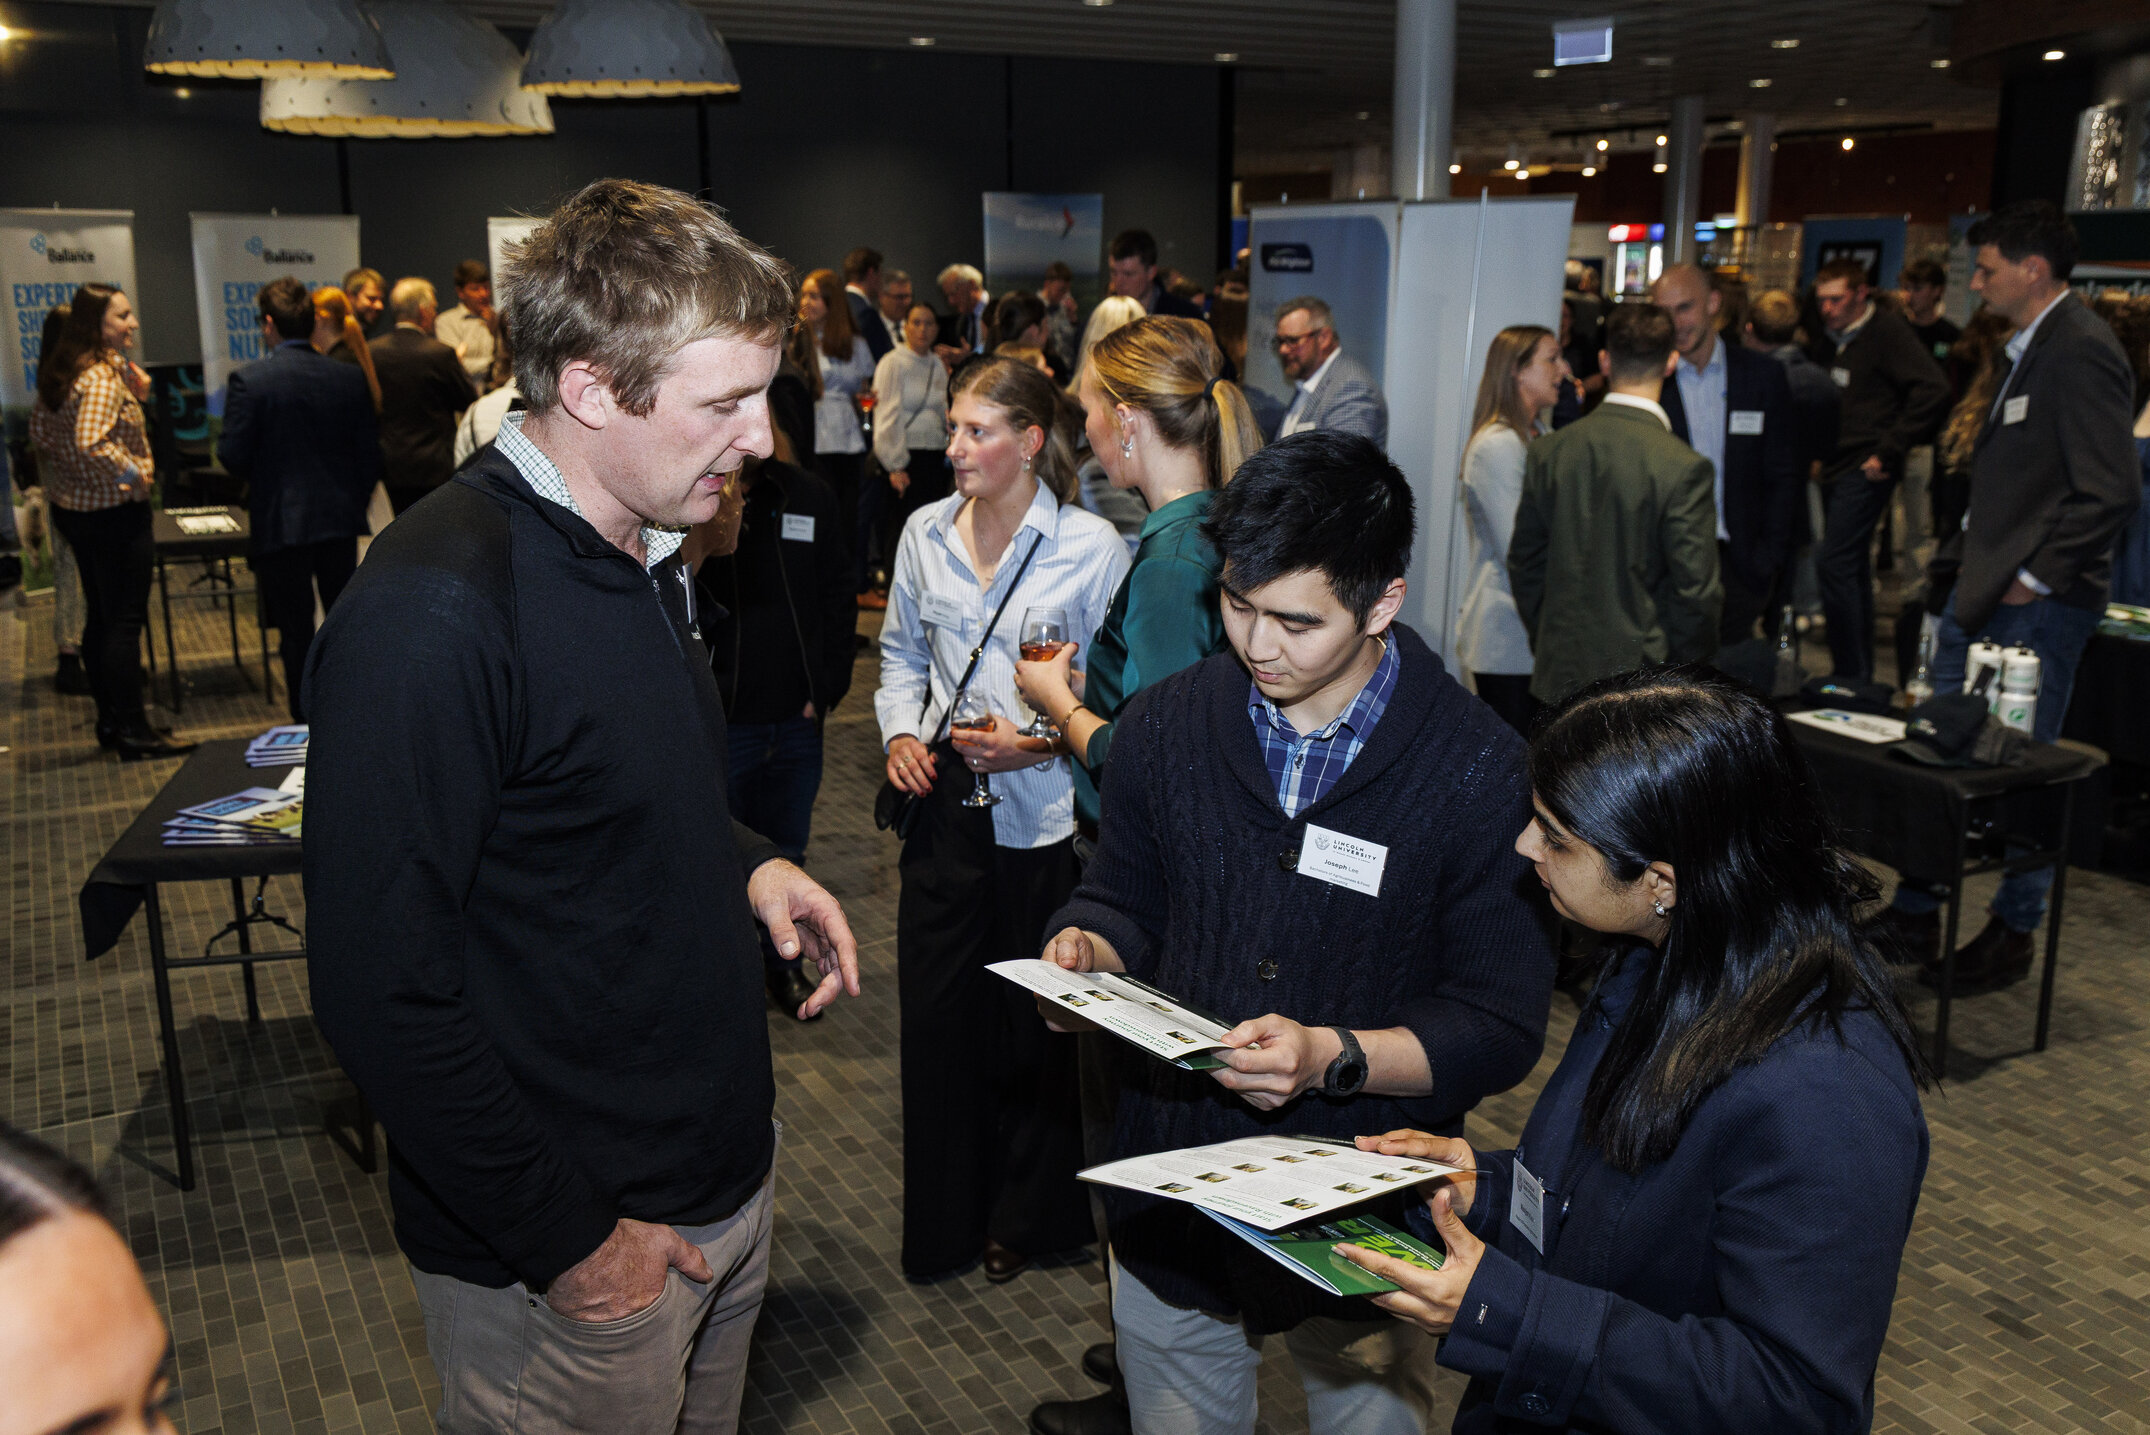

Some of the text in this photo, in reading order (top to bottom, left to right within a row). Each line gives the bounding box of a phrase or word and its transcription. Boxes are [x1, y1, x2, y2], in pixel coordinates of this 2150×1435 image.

[1333, 845, 1377, 860] UNIVERSITY
[1334, 840, 1364, 852] LINCOLN
[1324, 859, 1359, 874] Joseph Lee
